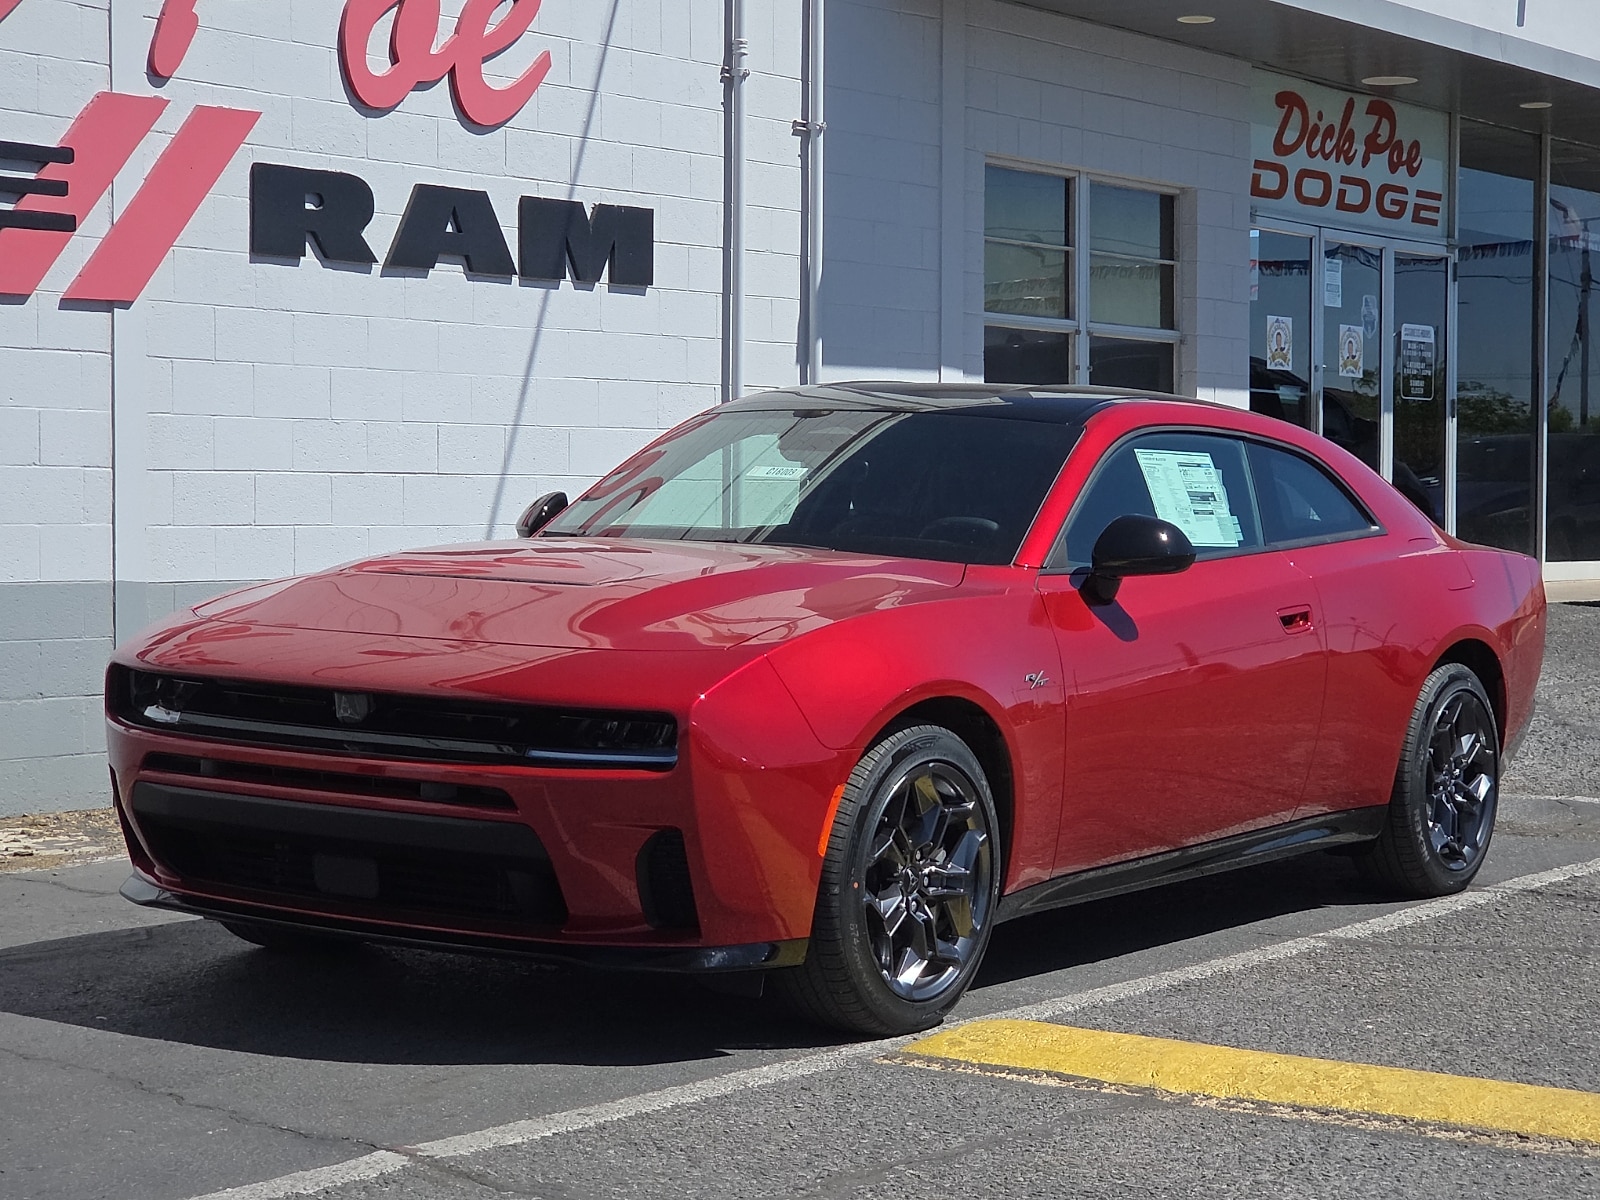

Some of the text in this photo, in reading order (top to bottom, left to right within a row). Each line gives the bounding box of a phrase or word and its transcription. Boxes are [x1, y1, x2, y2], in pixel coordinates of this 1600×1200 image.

[1273, 90, 1423, 178] Dick Poe
[249, 162, 655, 287] RAM
[1251, 158, 1443, 227] DODGE
